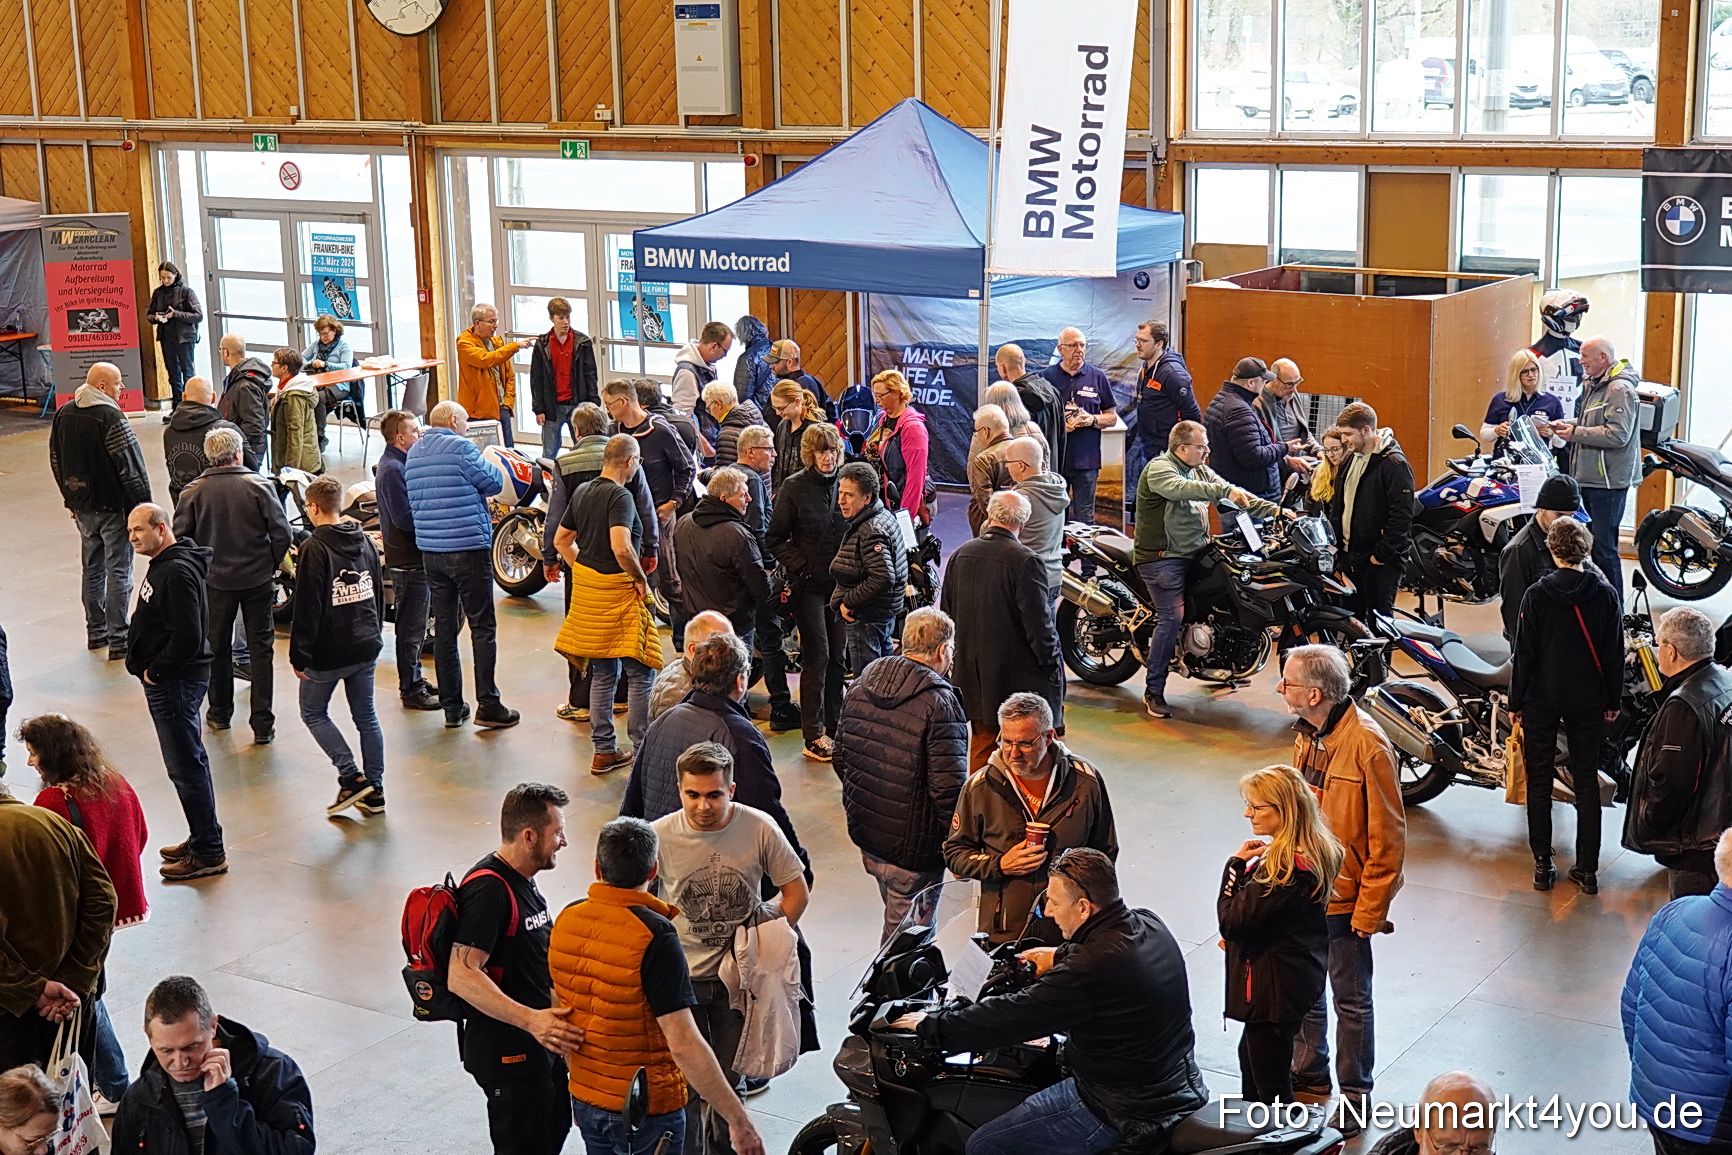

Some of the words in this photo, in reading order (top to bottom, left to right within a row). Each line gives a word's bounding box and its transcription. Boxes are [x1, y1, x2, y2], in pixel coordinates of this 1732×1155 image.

[1061, 44, 1109, 239] Motorrad
[1023, 124, 1062, 238] BMW
[1663, 198, 1699, 213] BMW
[313, 243, 354, 255] FRANKEN-BIKE
[326, 257, 340, 267] März
[341, 257, 355, 268] 2024
[620, 260, 634, 270] FRA
[644, 247, 695, 269] BMW
[700, 249, 790, 273] Motorrad
[70, 263, 108, 272] Motorrad
[313, 266, 340, 274] STADTHALLE
[64, 275, 115, 286] Aufbereitung
[58, 287, 73, 296] und
[74, 286, 124, 297] Versiegelung
[54, 304, 64, 313] Ihr
[64, 299, 78, 309] Bike
[79, 297, 85, 305] in
[86, 297, 105, 306] guten
[68, 333, 122, 342] 09181/4639305
[902, 346, 955, 367] MAKE
[895, 365, 929, 385] IFE
[931, 369, 946, 386] A
[525, 910, 551, 931] CHAS
